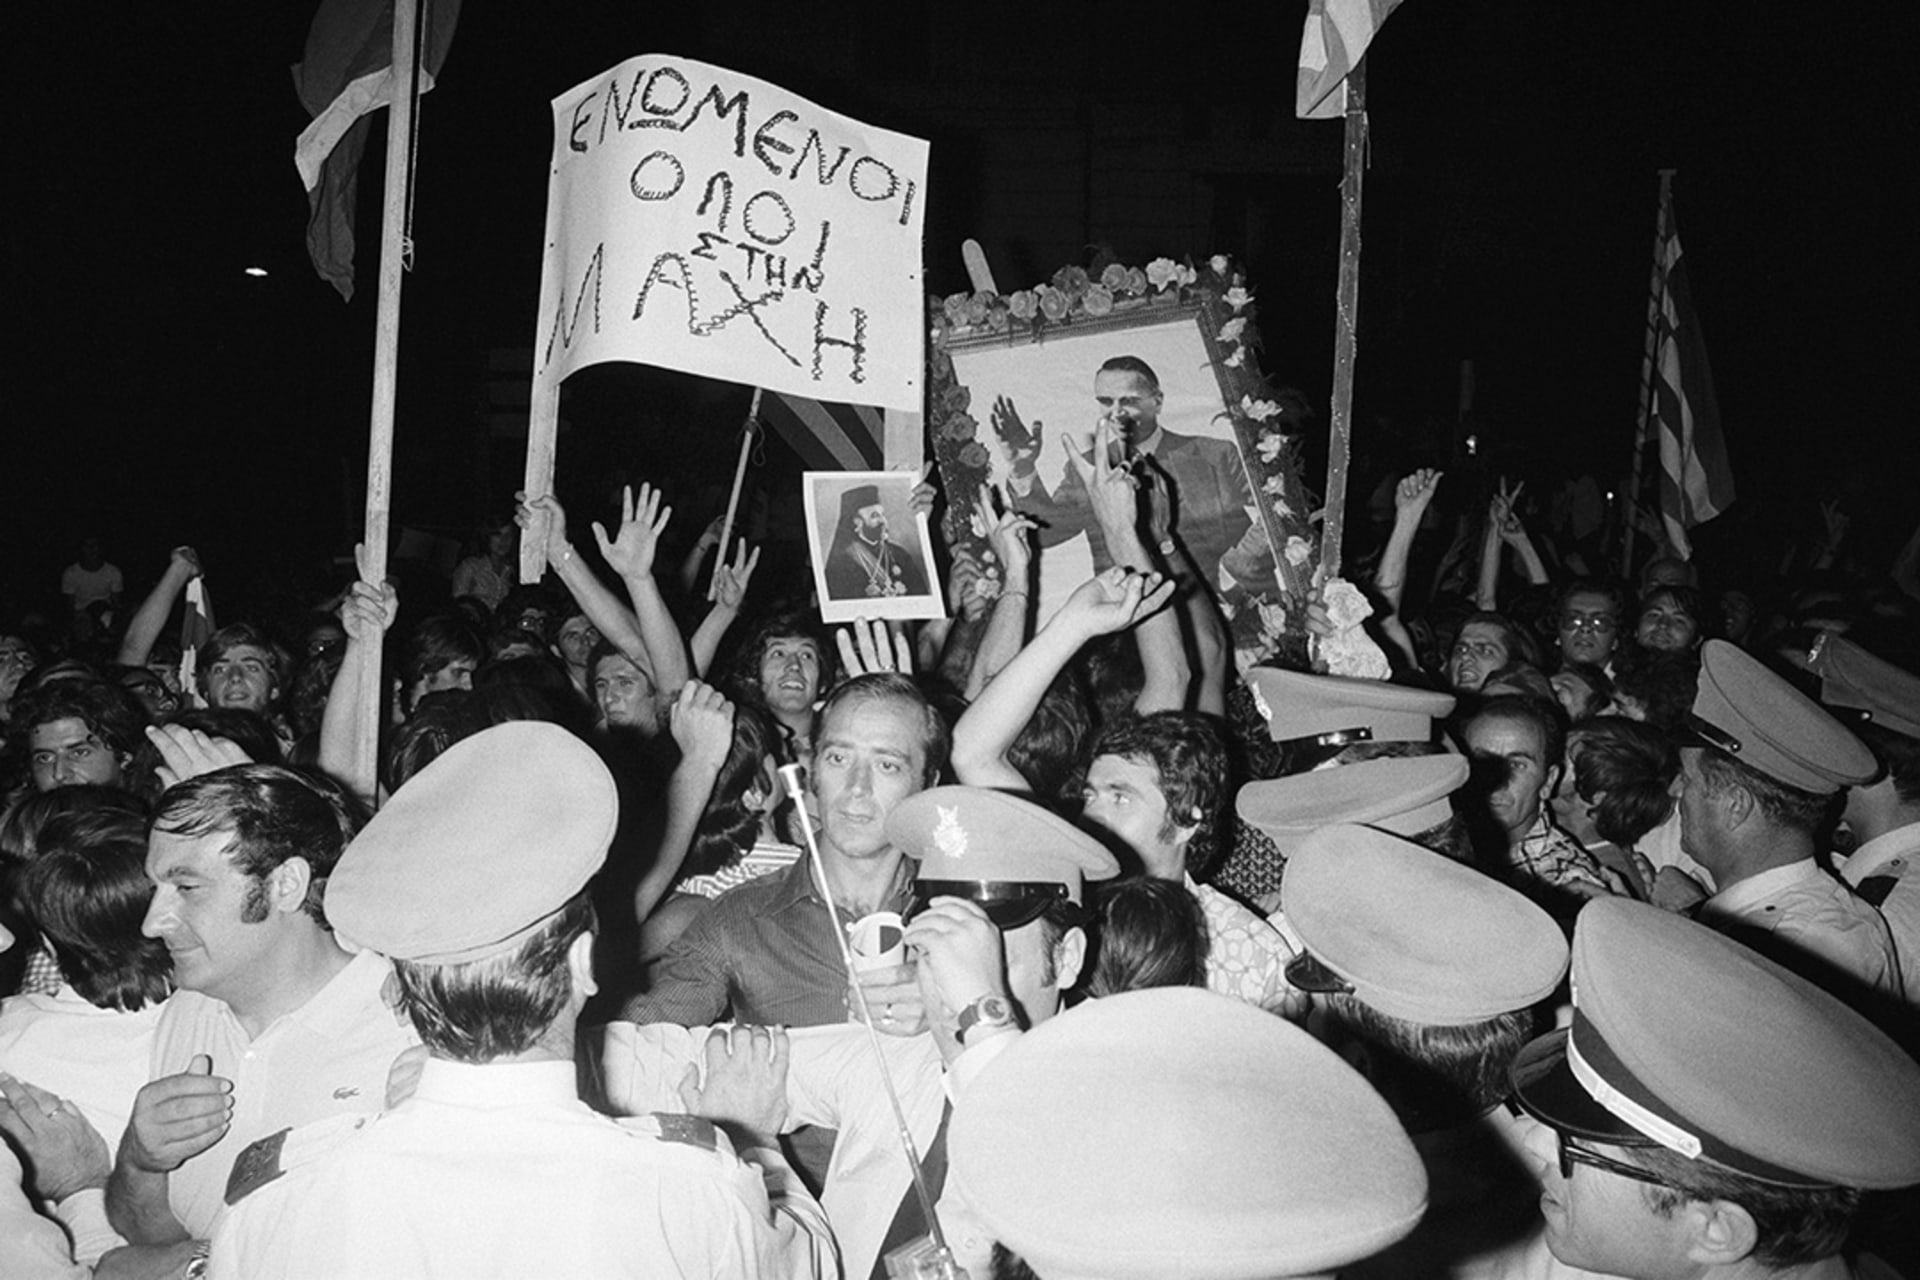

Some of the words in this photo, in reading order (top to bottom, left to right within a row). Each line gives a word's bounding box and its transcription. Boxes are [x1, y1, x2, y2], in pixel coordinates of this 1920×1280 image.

[569, 67, 915, 226] ΕΝΩΜΕΝΟΙ
[545, 241, 867, 383] ΜΑΧΗ
[690, 232, 826, 293] ΣΤΗΝ
